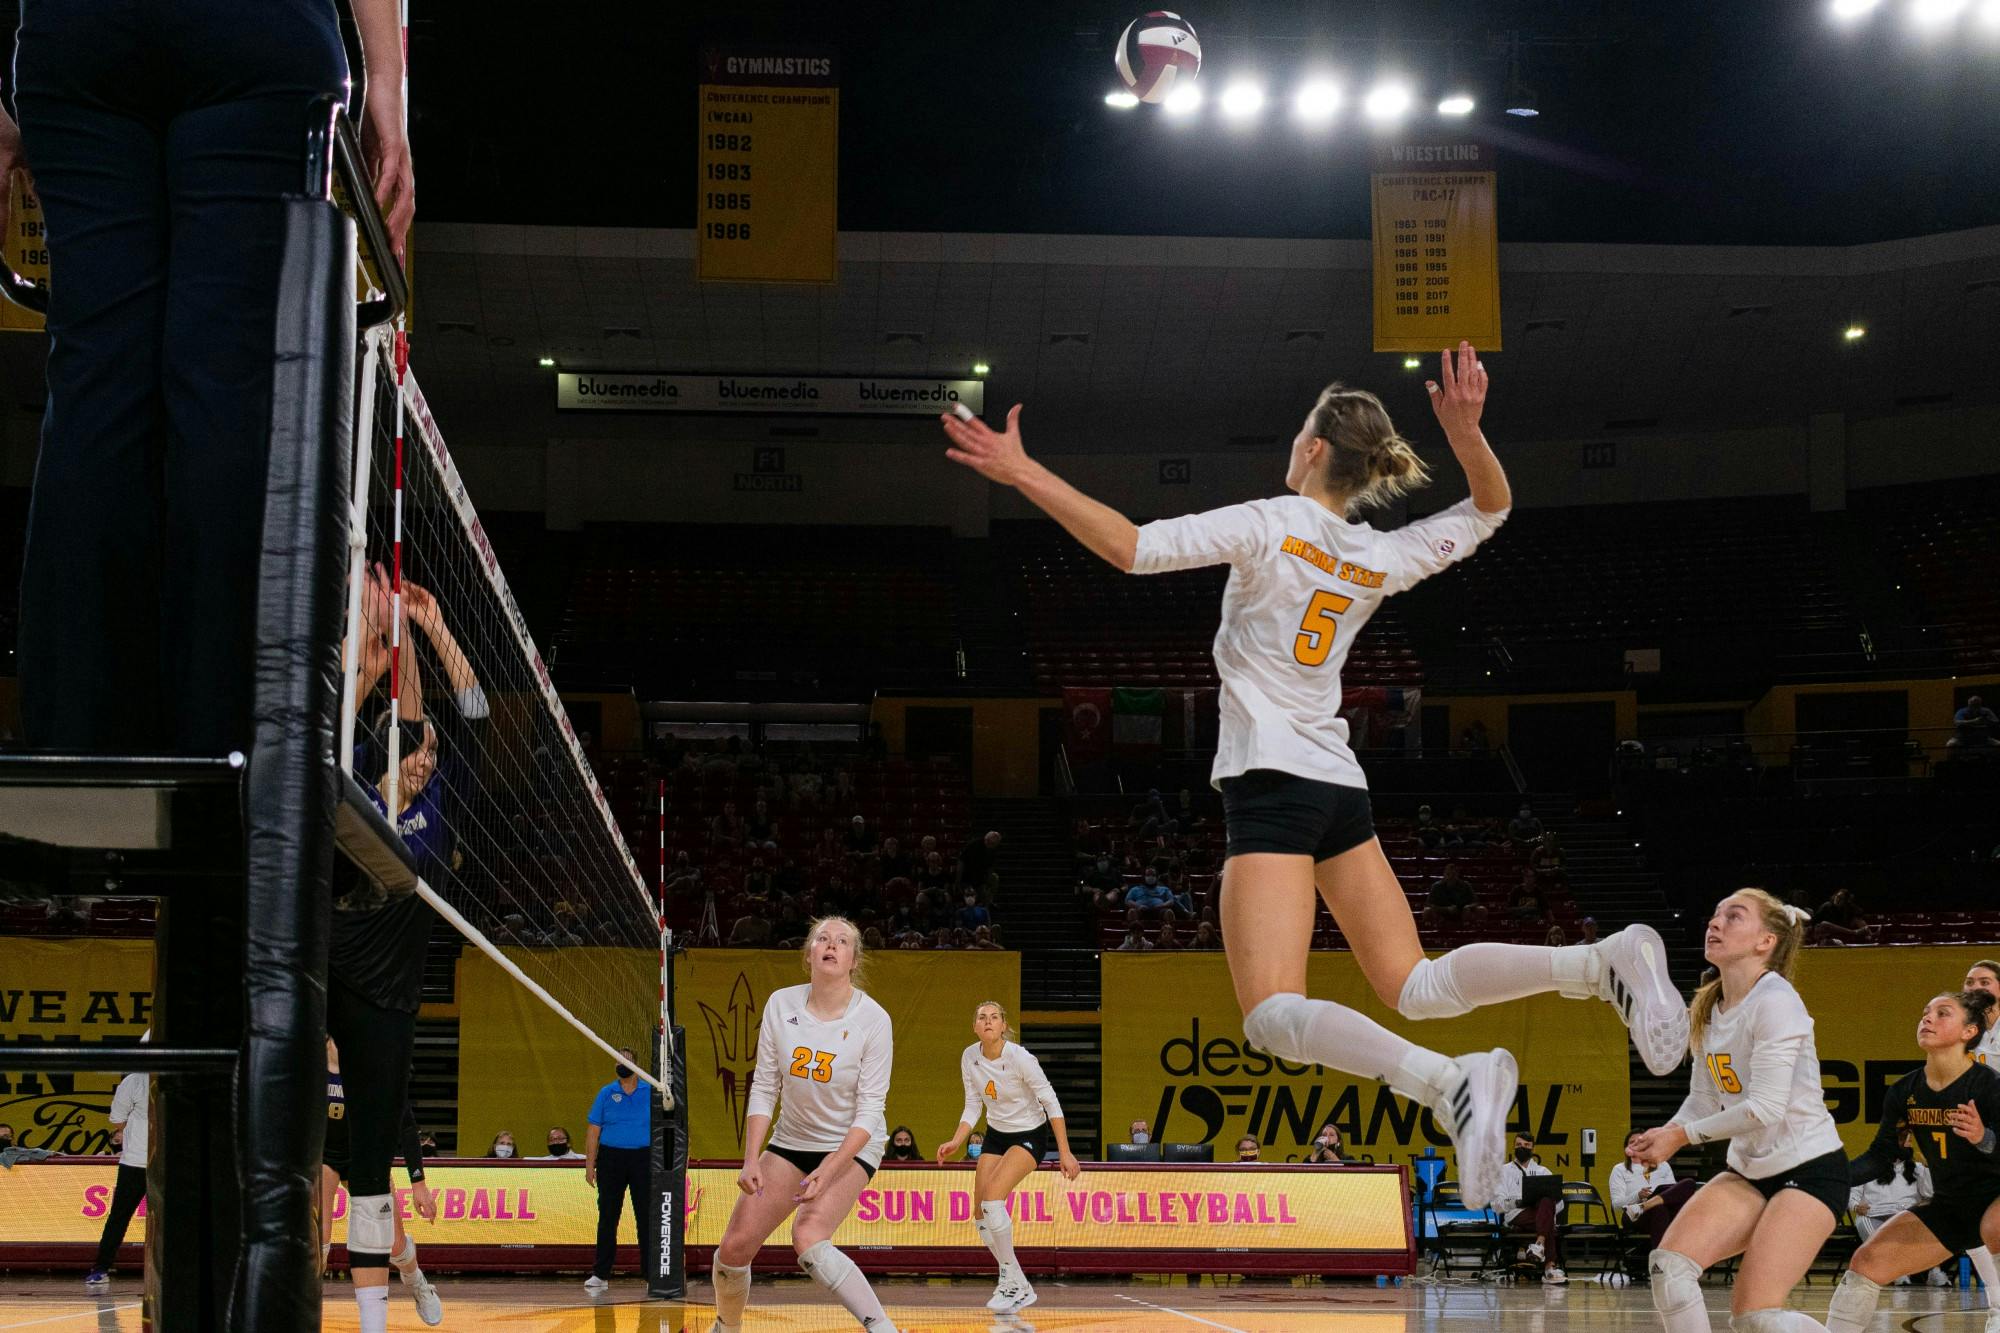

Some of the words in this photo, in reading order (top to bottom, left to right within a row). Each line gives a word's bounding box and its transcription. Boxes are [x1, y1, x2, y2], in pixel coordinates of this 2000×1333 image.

[727, 56, 831, 76] GYMNASTICS
[708, 134, 751, 151] 1982
[1392, 145, 1480, 161] WRESTLING
[707, 163, 750, 181] 1983
[707, 193, 750, 210] 1985
[707, 222, 750, 240] 1986
[577, 377, 678, 397] bluemedia
[719, 379, 819, 399] bluemedia
[859, 382, 959, 402] bluemedia
[1293, 588, 1355, 668] 5
[789, 1046, 838, 1084] 23
[1706, 1053, 1743, 1094] 15
[984, 1080, 998, 1100] 4
[1931, 1131, 1948, 1159] 7
[857, 1189, 935, 1222] SUN
[1066, 1190, 1298, 1223] VOLLEYBALL
